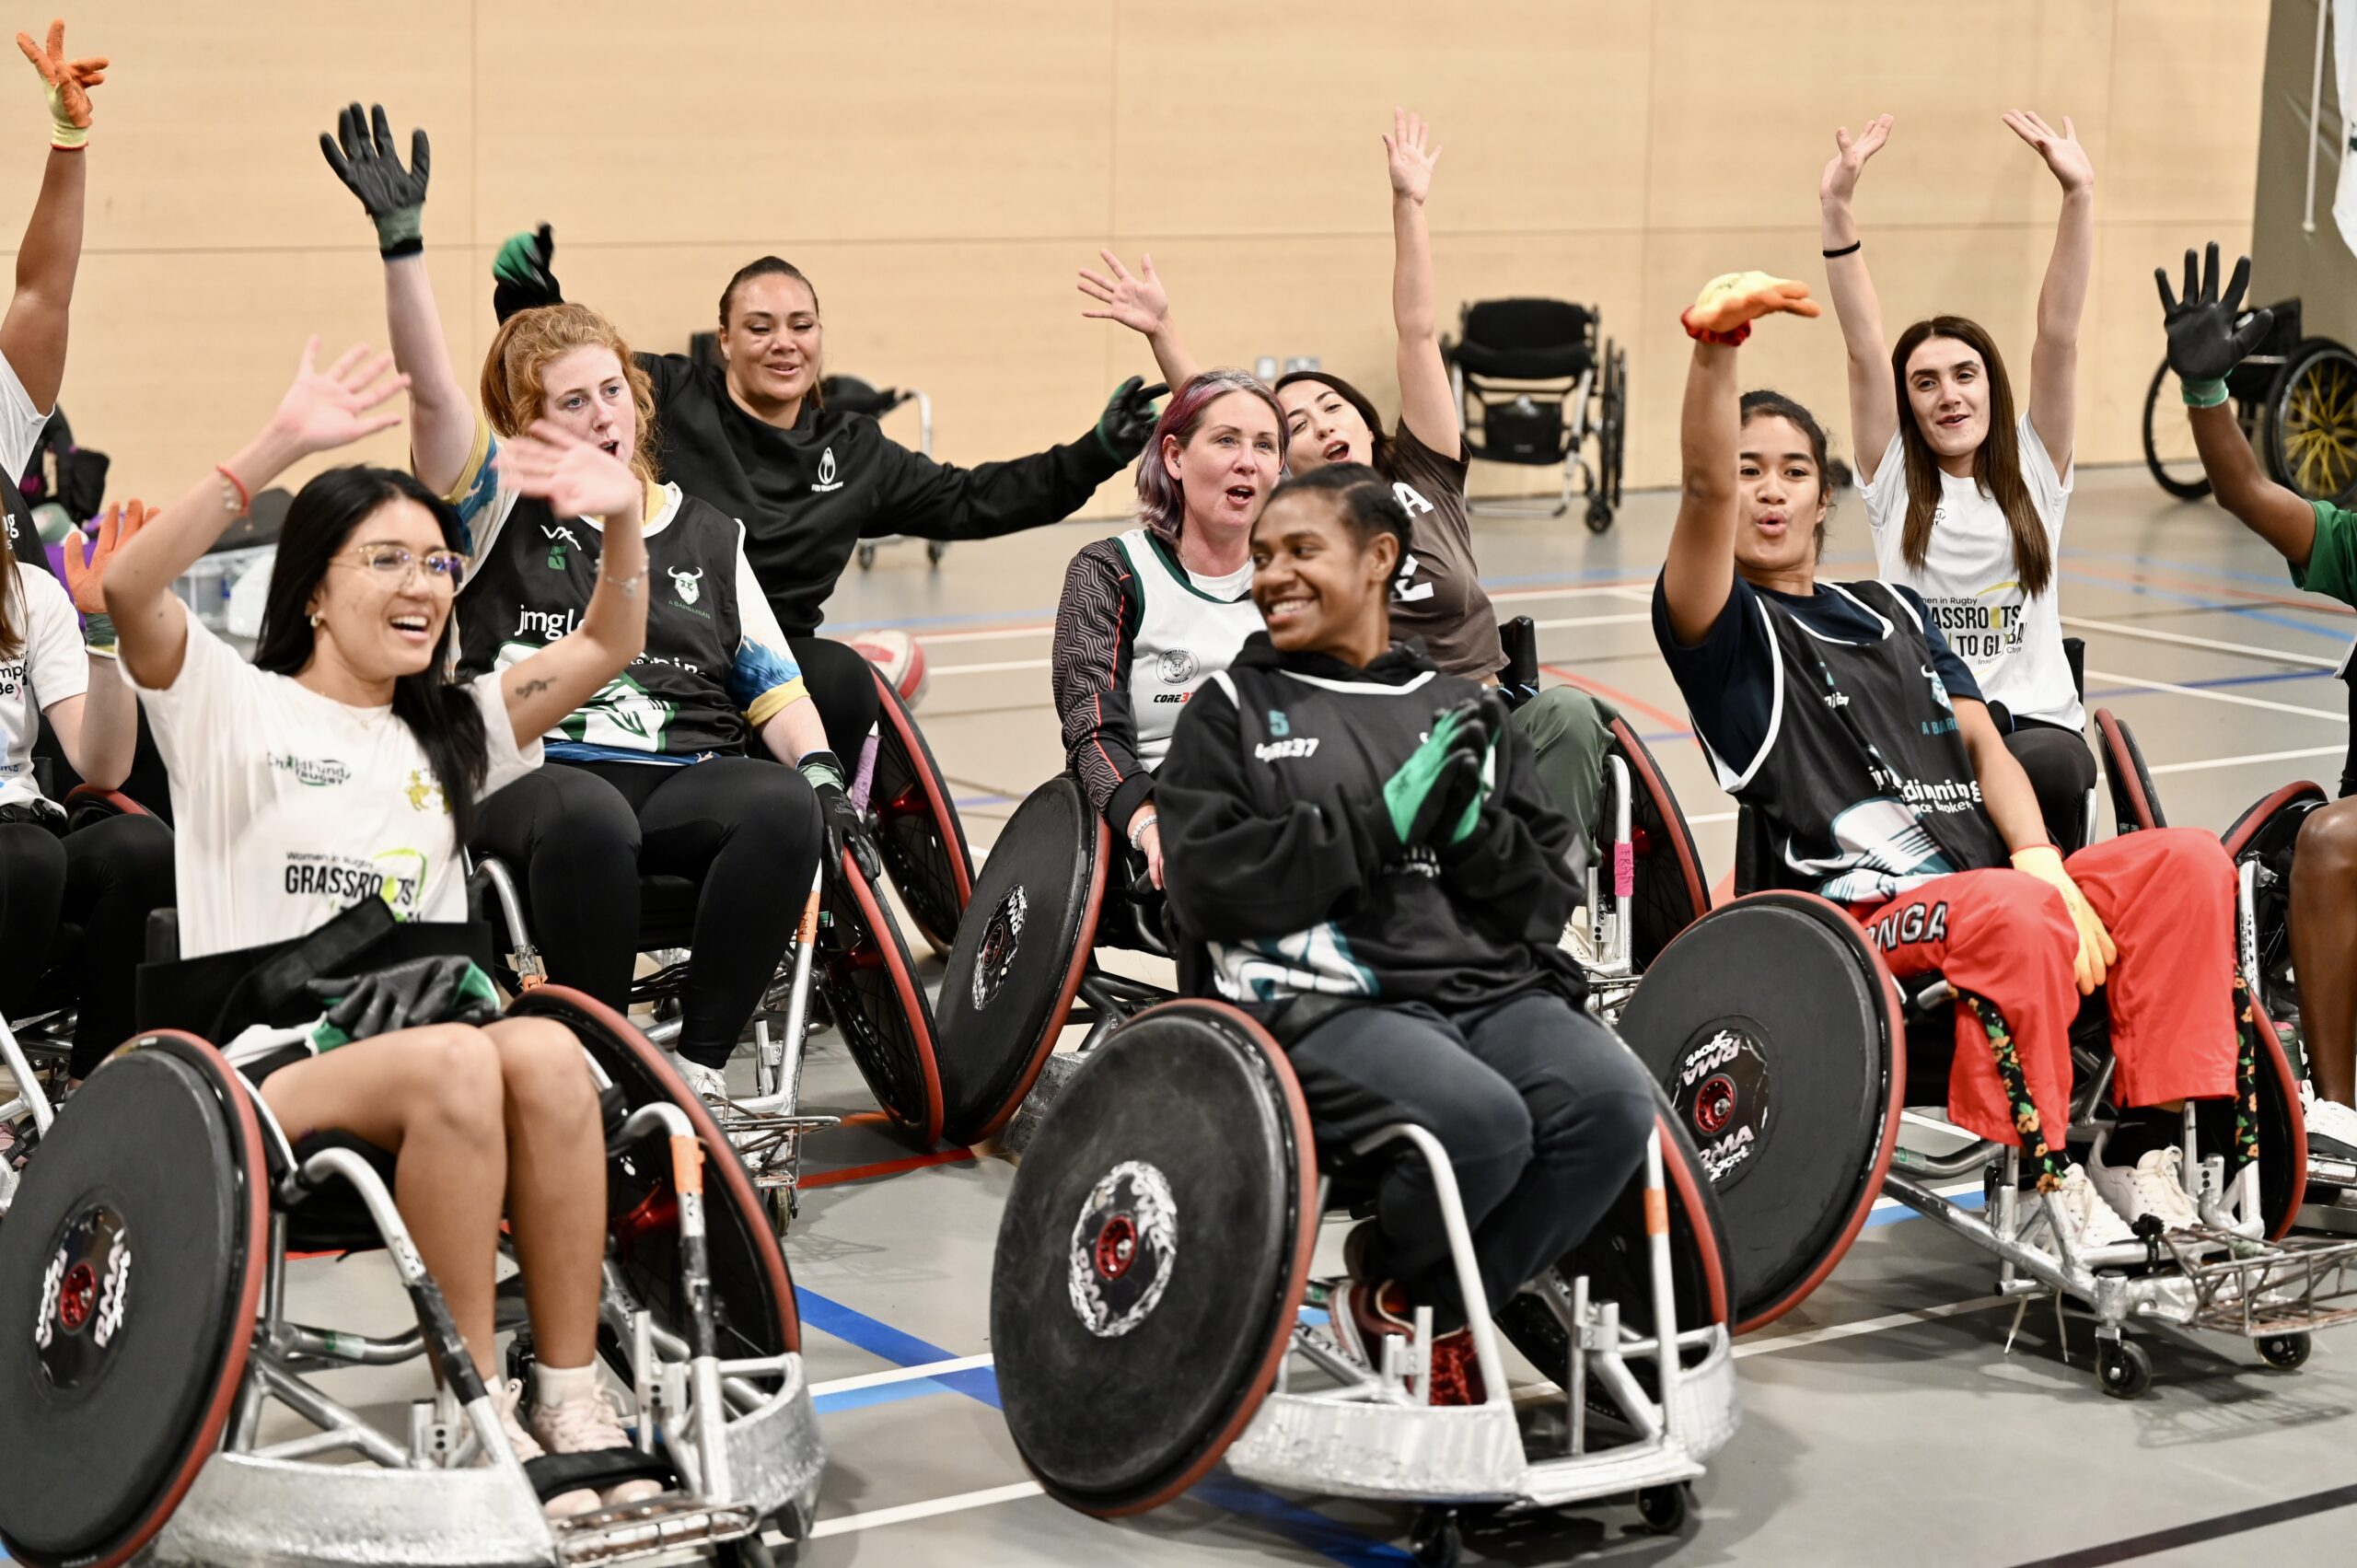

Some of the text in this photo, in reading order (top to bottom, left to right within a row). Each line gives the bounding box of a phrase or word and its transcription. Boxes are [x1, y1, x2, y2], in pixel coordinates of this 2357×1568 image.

[1950, 597, 1978, 606] Rugby
[1956, 635, 1979, 657] TO
[1268, 709, 1290, 737] 5
[1682, 1039, 1741, 1086] RMA
